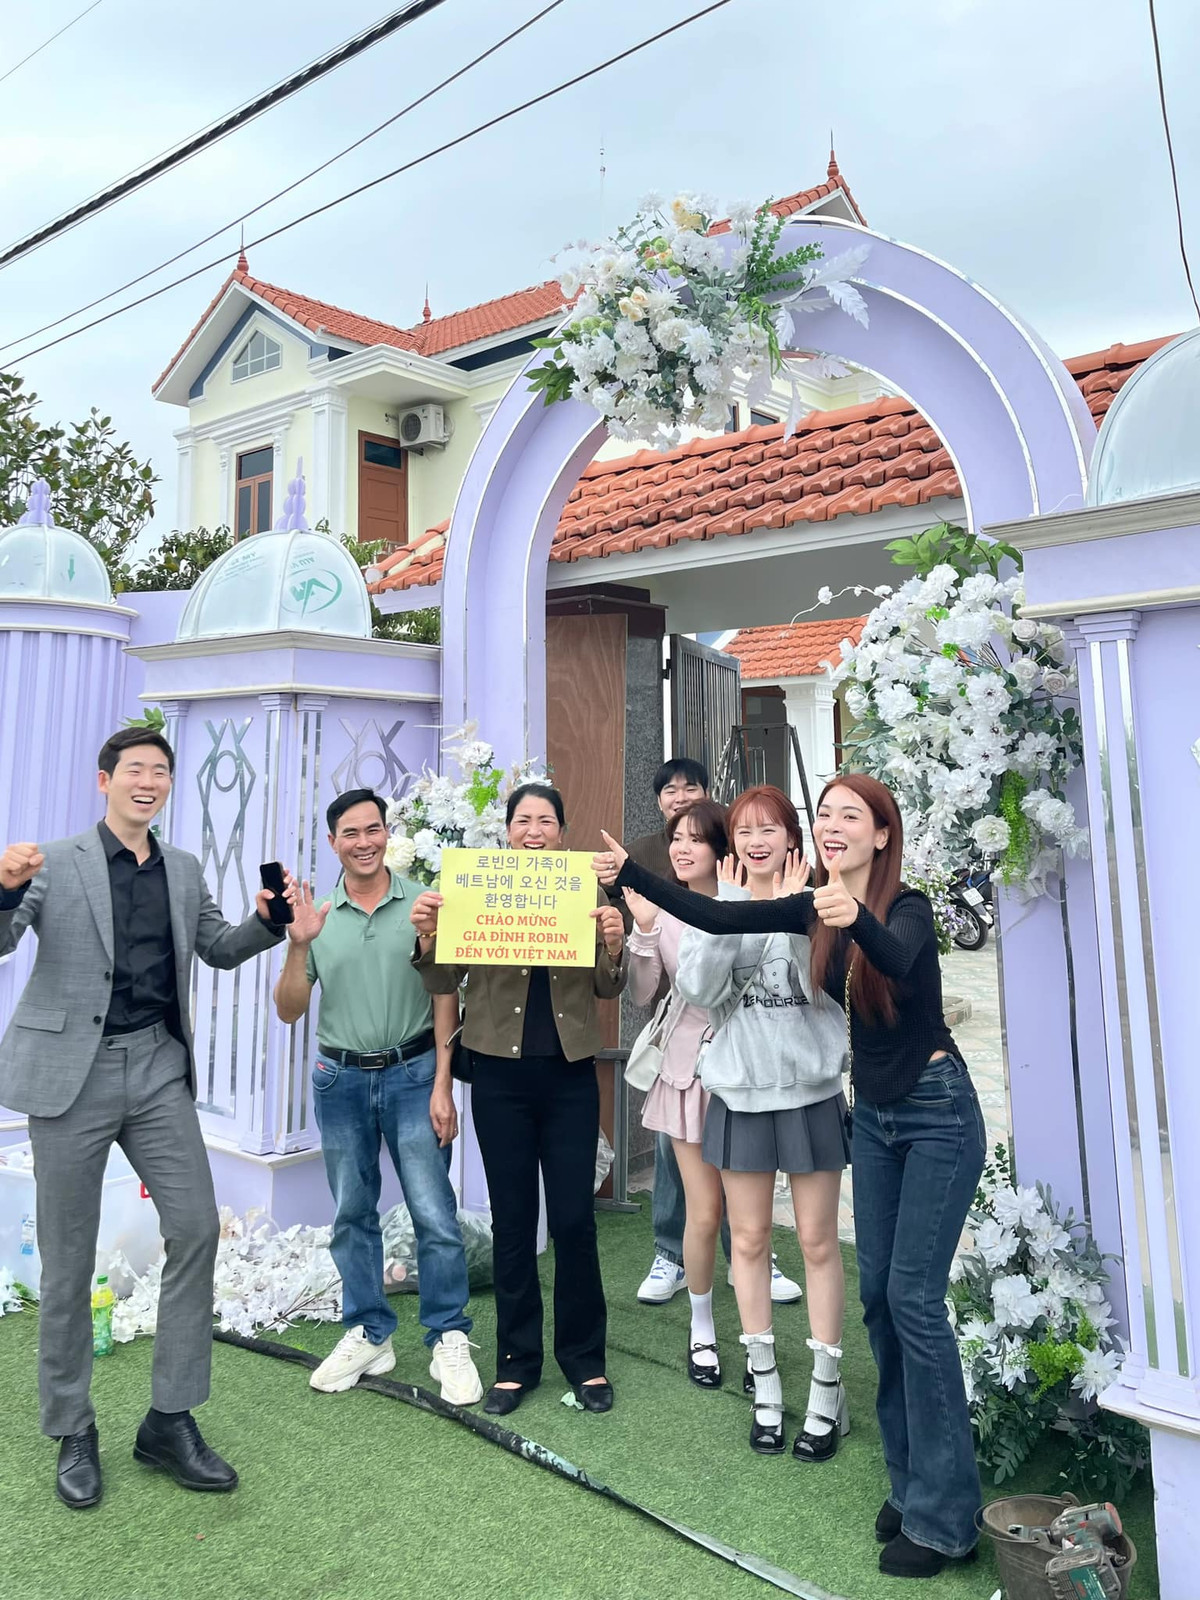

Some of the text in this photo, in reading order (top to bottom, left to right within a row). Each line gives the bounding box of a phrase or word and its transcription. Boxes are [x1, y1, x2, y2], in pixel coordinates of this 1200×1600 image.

[476, 855, 568, 872] 로빈의 가족이
[456, 873, 582, 891] 베트남에 오신 것을
[484, 893, 558, 910] 환영합니다
[476, 912, 557, 927] CHÀO MỪNG
[463, 929, 569, 944] GIA ĐÌNH ROBIN
[455, 944, 577, 962] ĐẾN VỚI VIỆT NAM
